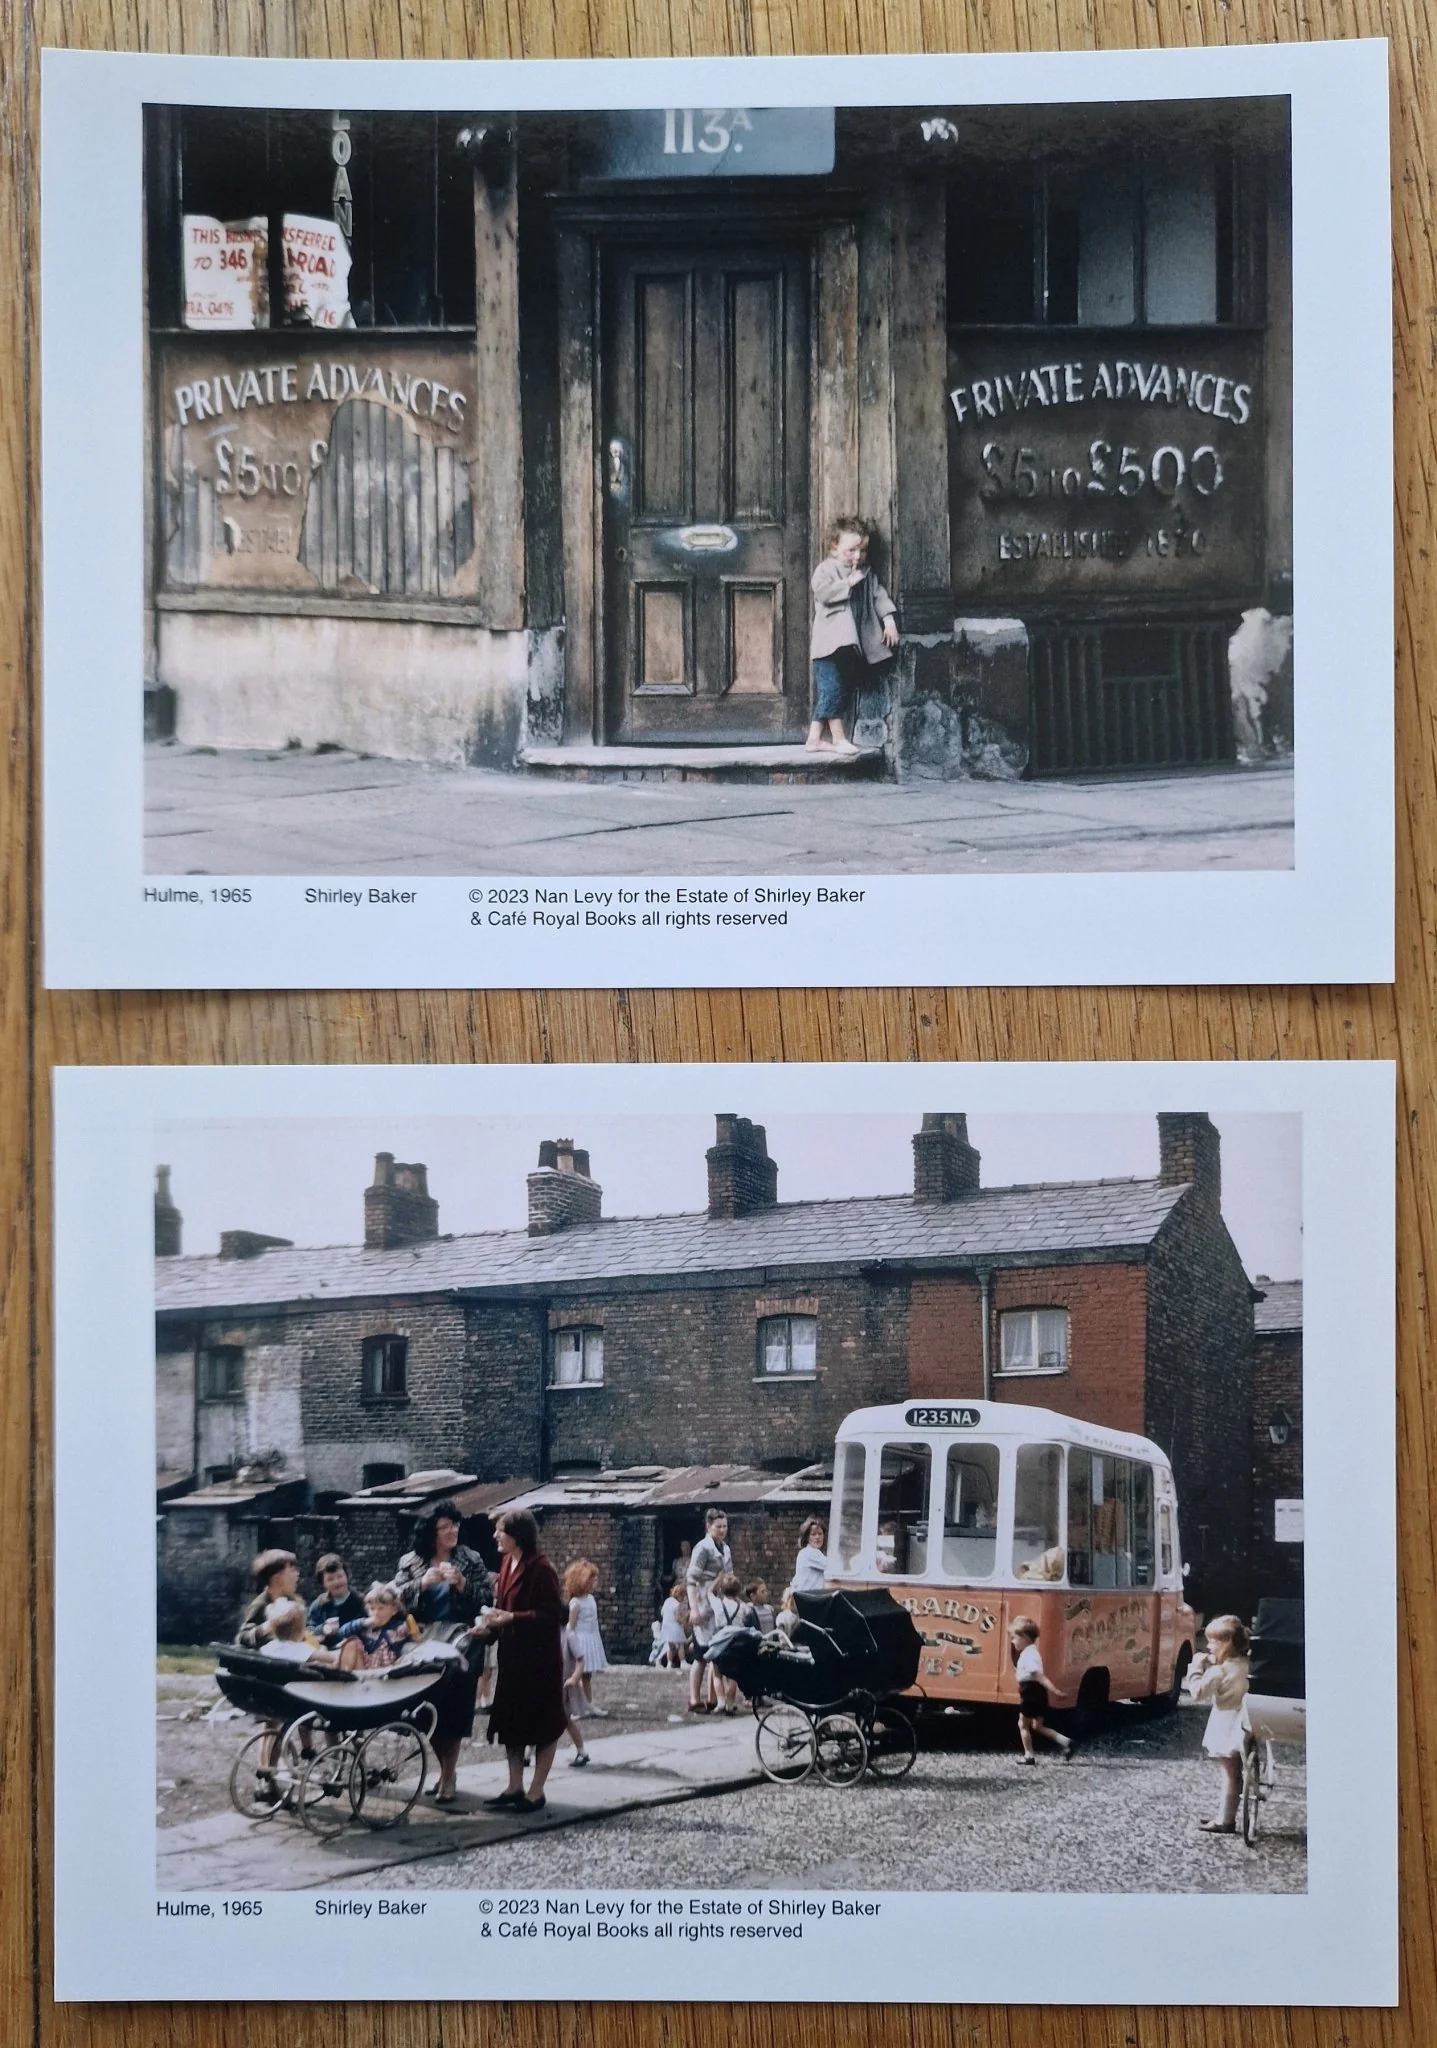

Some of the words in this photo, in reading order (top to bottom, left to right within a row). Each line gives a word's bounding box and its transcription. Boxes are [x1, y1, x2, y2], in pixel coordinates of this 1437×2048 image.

[332, 109, 352, 247] LOAN
[192, 228, 221, 244] THIS
[194, 256, 213, 270] TO
[219, 248, 248, 270] 346
[175, 364, 298, 427] PRIVATE
[1092, 362, 1251, 425] ADVANCES
[1087, 440, 1224, 496] £500
[143, 887, 204, 906] Hulme,
[210, 887, 253, 904] 1965
[304, 887, 364, 908] Shirley
[368, 887, 418, 904] Baker
[468, 888, 484, 904] ©
[487, 888, 530, 904] 2023
[535, 888, 569, 904] Nan
[574, 888, 614, 908] Levy
[617, 888, 641, 904] for
[644, 888, 671, 904] the
[676, 888, 729, 904] Estate
[733, 887, 750, 903] of
[754, 887, 812, 907] Shirley
[817, 887, 866, 903] Baker
[470, 910, 483, 926] &
[487, 910, 528, 927] Café
[532, 910, 580, 930] Royal
[585, 910, 637, 926] Books
[641, 910, 660, 926] all
[665, 910, 711, 930] rights
[716, 909, 788, 926] reserved
[920, 1656, 964, 1678] ES
[156, 1900, 215, 1919] Hulme,
[221, 1900, 263, 1917] 1965
[315, 1899, 373, 1920] Shirley
[378, 1899, 428, 1916] Baker
[478, 1898, 494, 1915] ©
[498, 1898, 540, 1915] 2023
[545, 1898, 580, 1915] Nan
[585, 1898, 625, 1919] Levy
[629, 1898, 653, 1915] for
[656, 1898, 684, 1916] the
[689, 1898, 743, 1916] Estate
[747, 1898, 764, 1916] of
[768, 1899, 827, 1920] Shirley
[831, 1899, 882, 1916] Baker
[480, 1921, 493, 1938] &
[498, 1920, 538, 1938] Café
[543, 1921, 591, 1942] Royal
[596, 1921, 649, 1938] Books
[654, 1921, 673, 1938] all
[678, 1921, 725, 1943] rights
[729, 1922, 803, 1939] reserved
